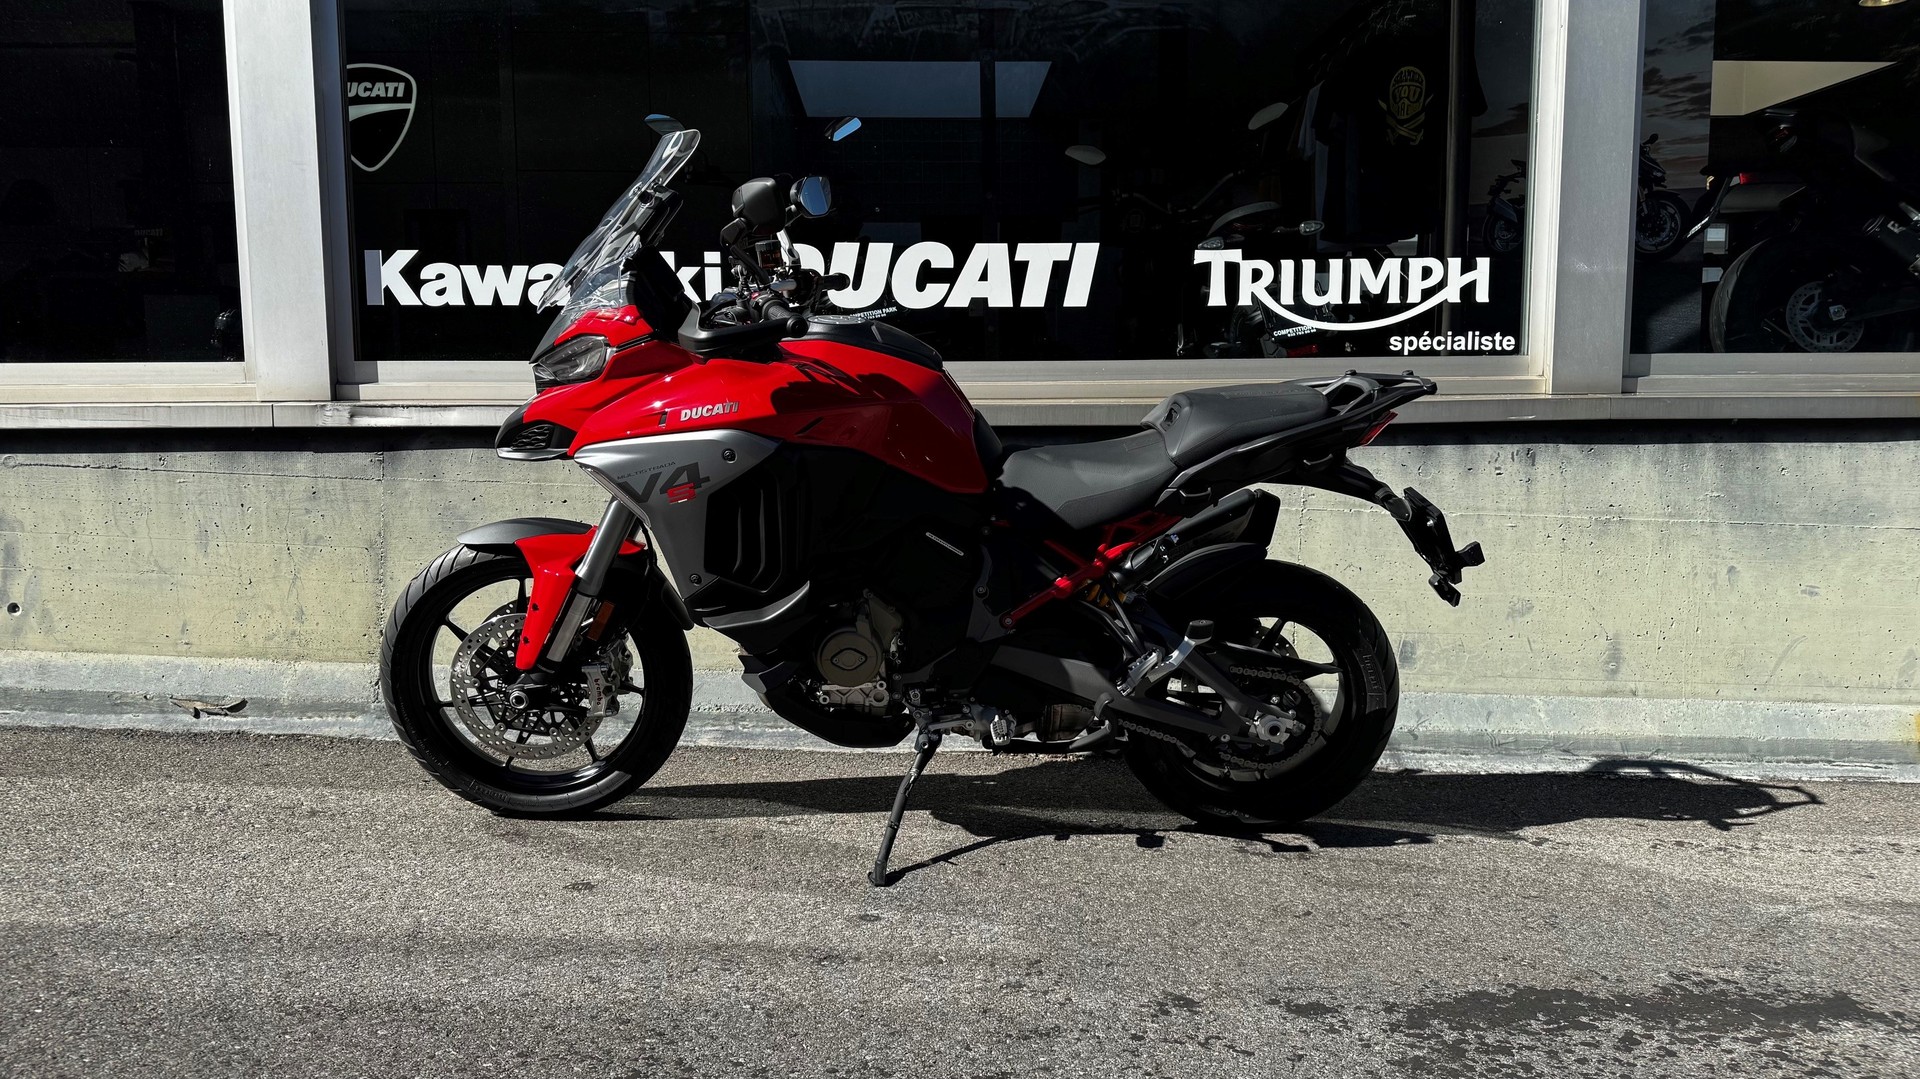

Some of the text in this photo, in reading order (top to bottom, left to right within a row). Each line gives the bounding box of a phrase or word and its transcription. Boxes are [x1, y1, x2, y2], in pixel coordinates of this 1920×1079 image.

[365, 249, 722, 306] Kawaki
[1194, 249, 1490, 330] TRIUMPH
[1389, 331, 1515, 355] spécialiste
[680, 402, 740, 422] DUCATI
[616, 462, 711, 503] V4
[617, 461, 676, 480] MULTISTRADA
[594, 677, 604, 706] brembo
